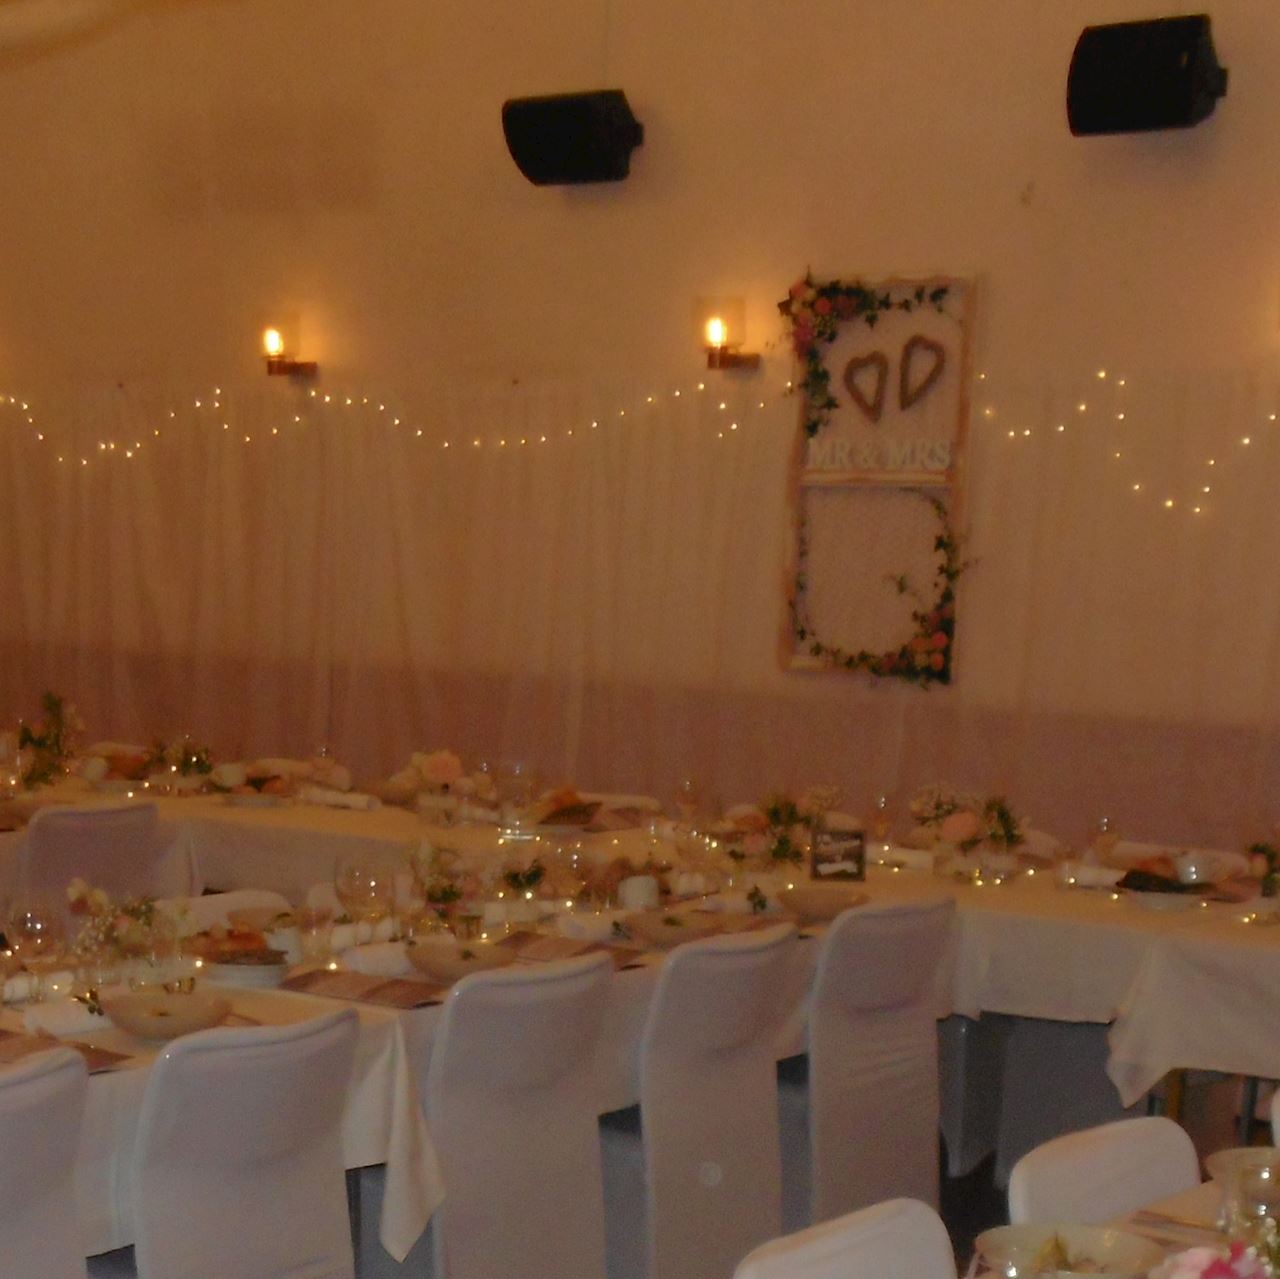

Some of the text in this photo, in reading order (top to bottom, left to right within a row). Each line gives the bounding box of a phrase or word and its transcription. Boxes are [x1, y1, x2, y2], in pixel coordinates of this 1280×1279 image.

[806, 437, 951, 471] MR & MRS
